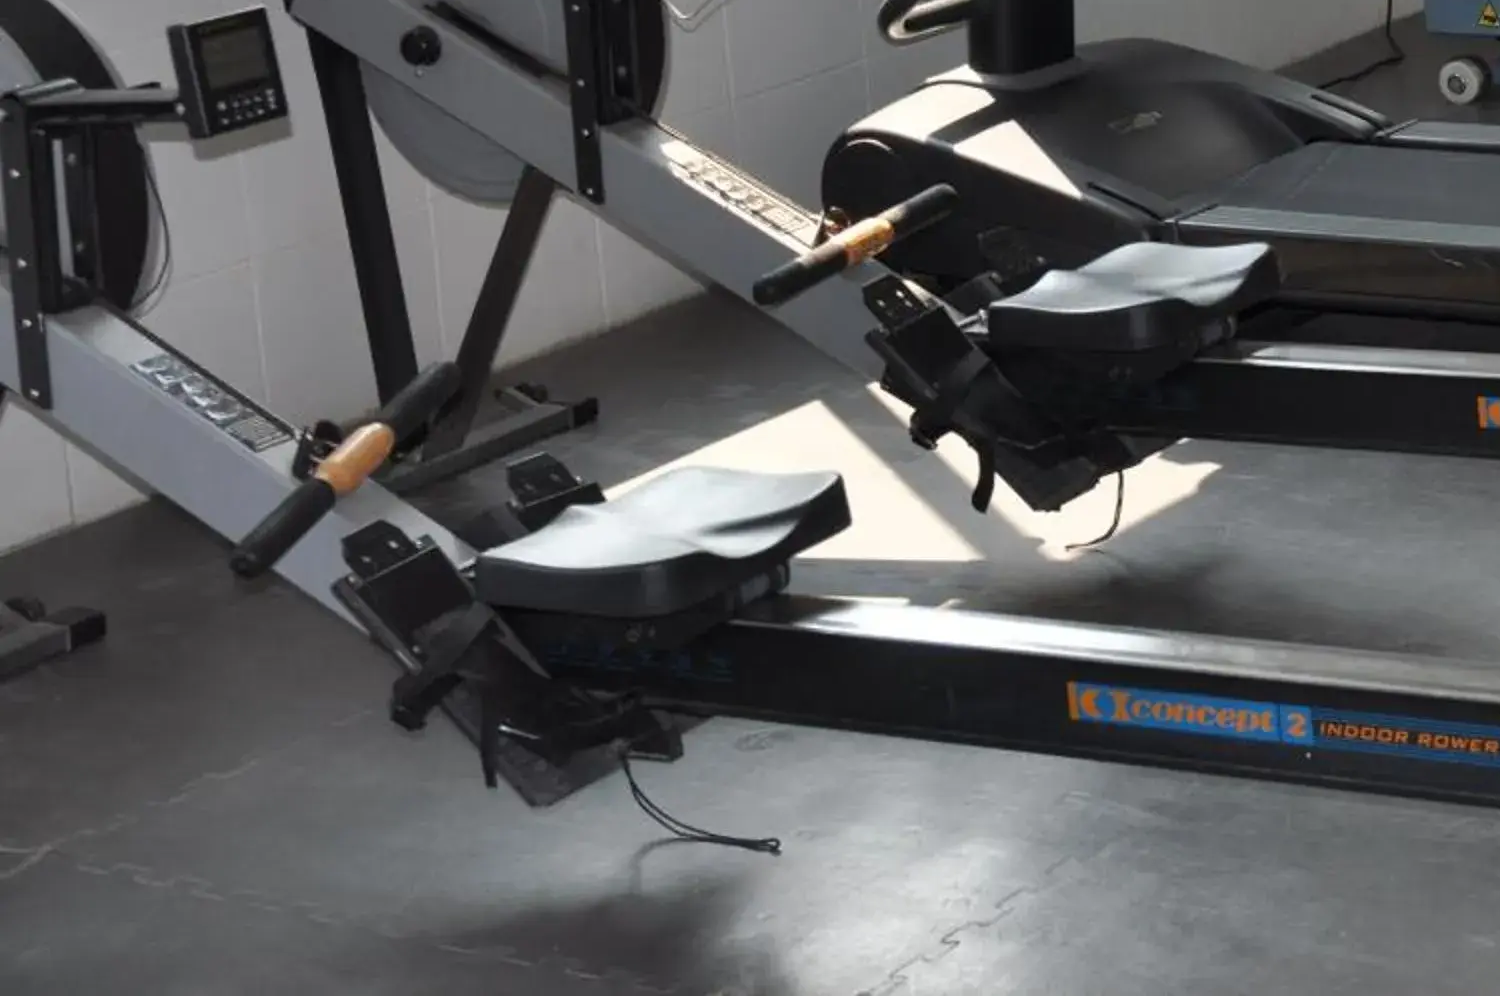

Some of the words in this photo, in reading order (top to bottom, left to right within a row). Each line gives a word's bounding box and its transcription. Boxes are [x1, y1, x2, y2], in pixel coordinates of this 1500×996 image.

[1131, 699, 1274, 732] concept
[1287, 712, 1307, 738] 2
[1319, 721, 1409, 744] INDOOR
[1417, 731, 1500, 753] ROWER
